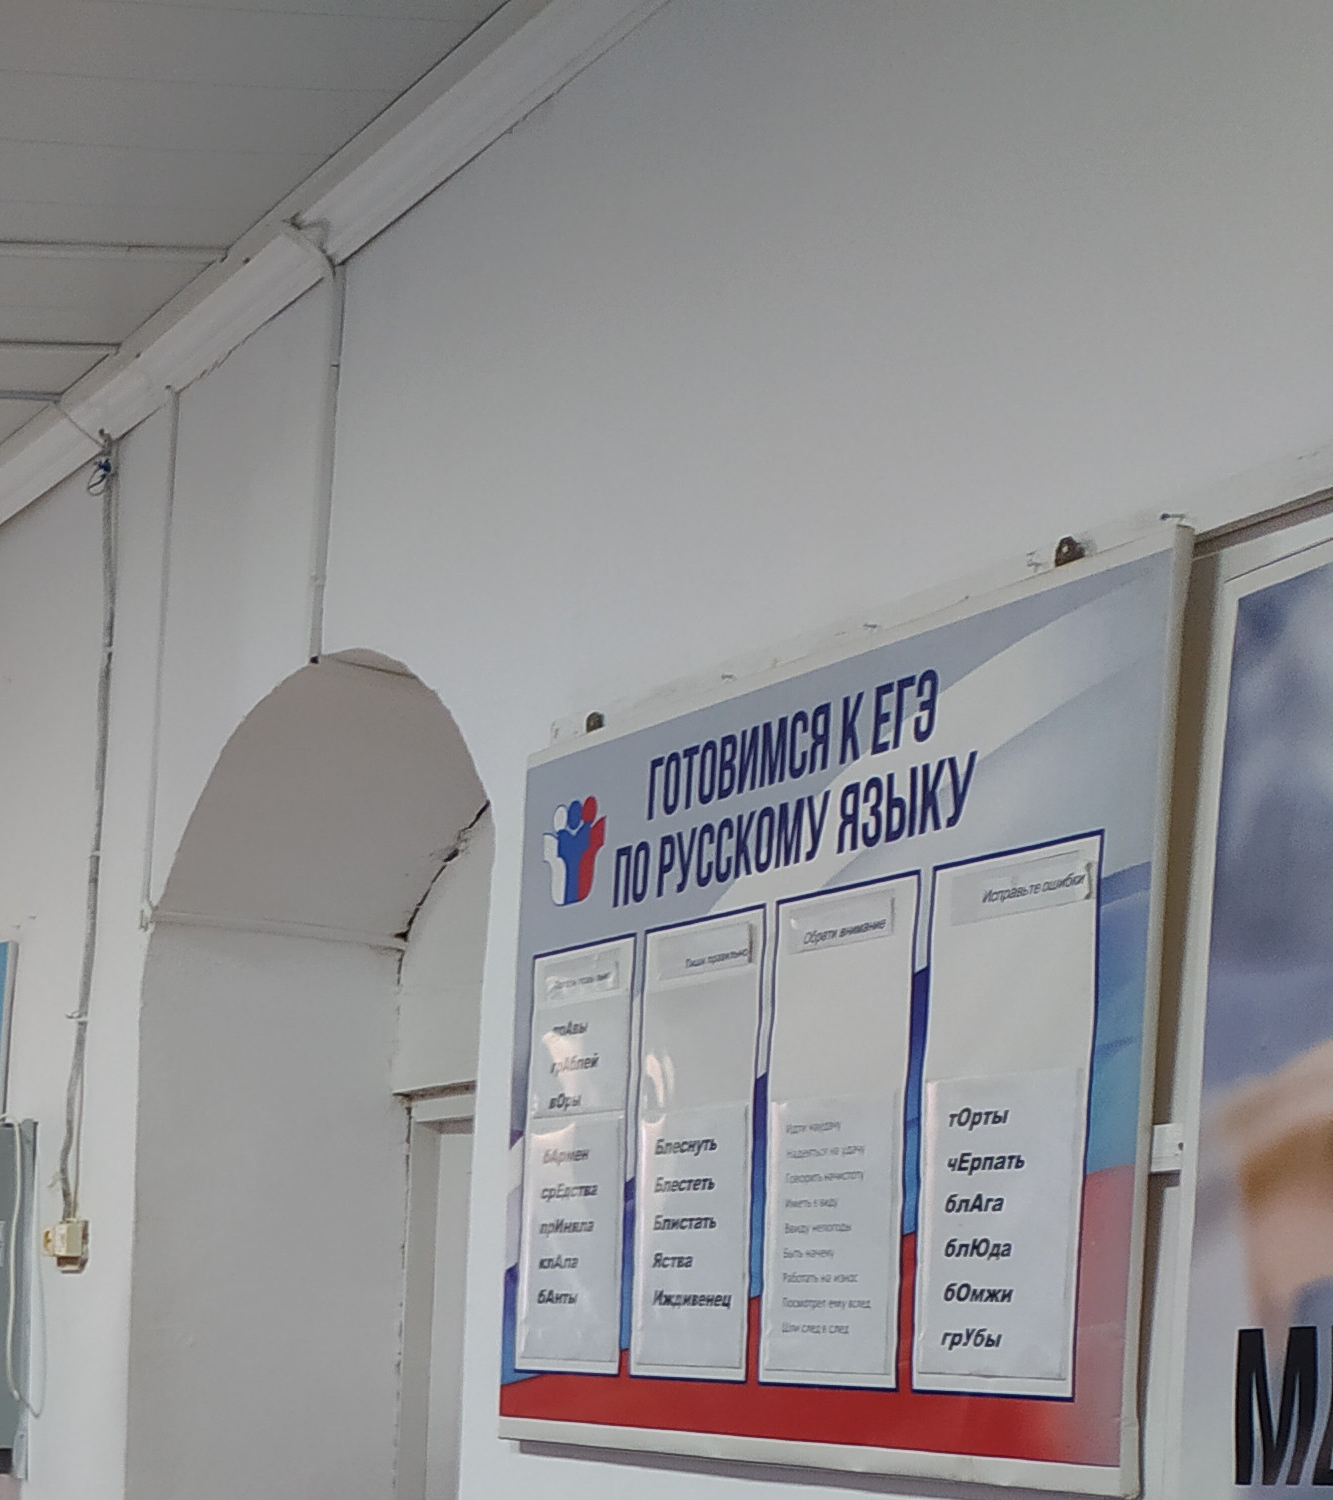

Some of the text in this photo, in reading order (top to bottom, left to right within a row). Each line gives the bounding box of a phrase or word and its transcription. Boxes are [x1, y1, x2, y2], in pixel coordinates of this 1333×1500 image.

[646, 668, 939, 821] ГОТОВИМСЯ К ЕГЭ
[612, 750, 978, 909] ПО РУССКОМУ ЯЗЫКУ
[949, 1108, 1009, 1131] тОрты
[655, 1139, 717, 1156] Блеснуть
[947, 1153, 1025, 1175] чЕрпать
[654, 1177, 715, 1193] Блестеть
[945, 1193, 1004, 1213] блАга
[653, 1215, 716, 1230] Блистать
[944, 1238, 1012, 1260] блЮда
[652, 1253, 693, 1268] Яства
[537, 1289, 578, 1304] бАнты
[653, 1290, 732, 1308] Иждивенец
[943, 1283, 1013, 1302] бОмжи
[941, 1328, 1002, 1350] грУбы
